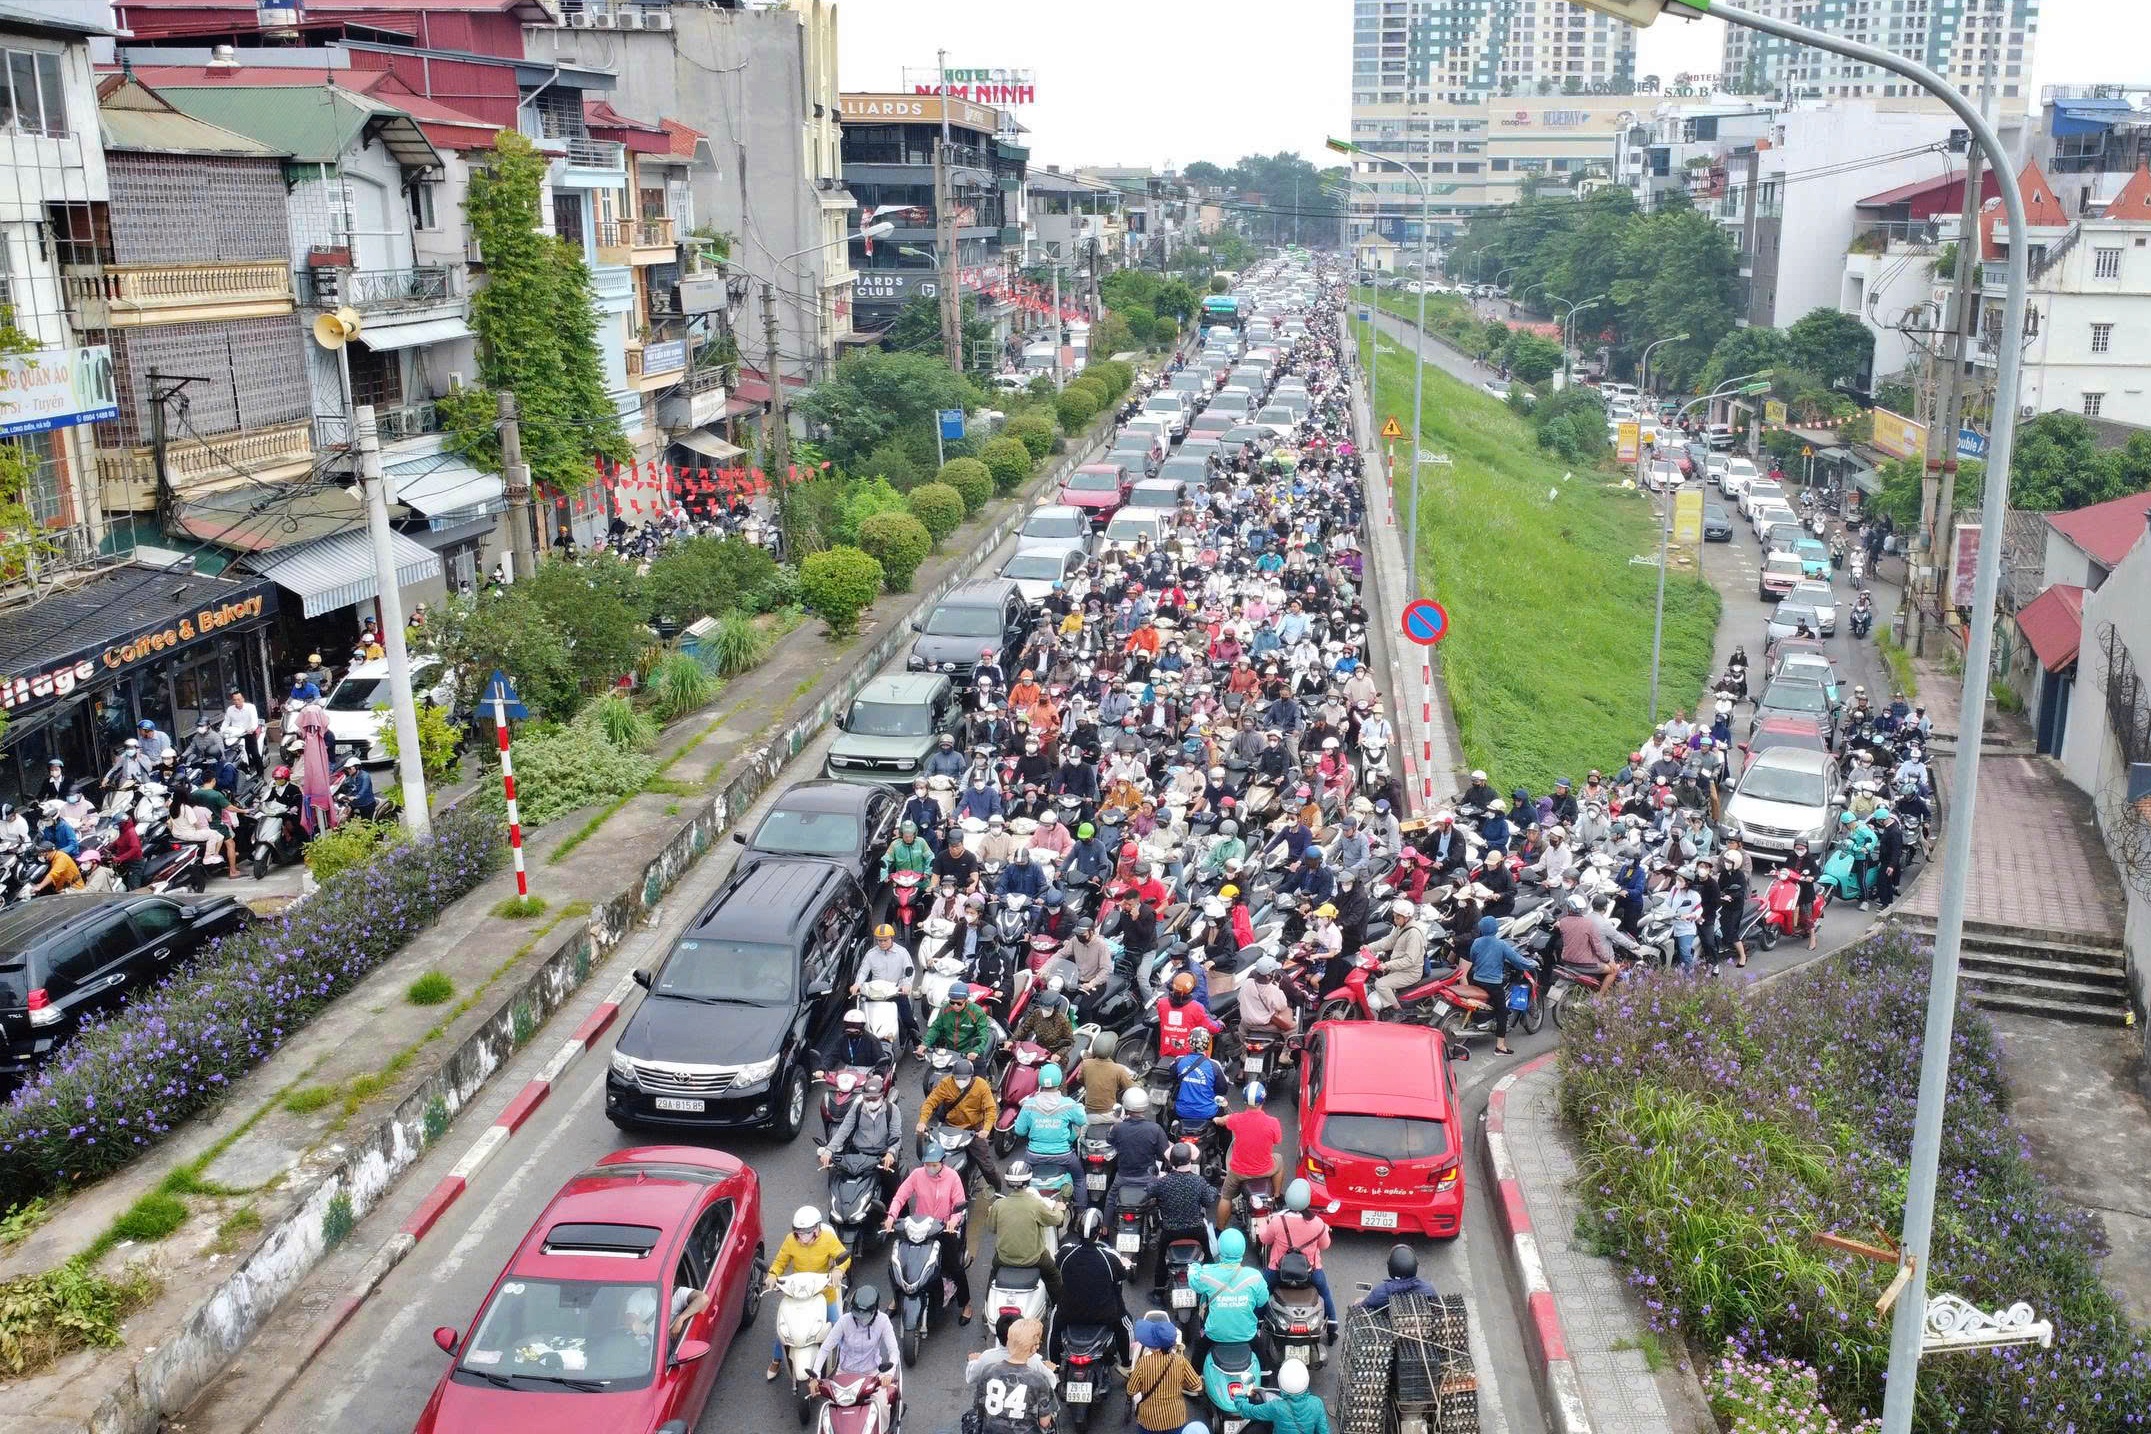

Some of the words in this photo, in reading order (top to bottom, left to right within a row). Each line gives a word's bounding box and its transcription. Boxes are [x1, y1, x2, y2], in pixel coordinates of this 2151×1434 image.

[944, 69, 992, 81] HOTEL
[976, 85, 1034, 103] NINH
[838, 101, 922, 115] LLIARDS
[857, 287, 894, 296] CLUB
[102, 629, 177, 669] Coffee
[179, 618, 196, 641] &
[198, 594, 263, 633] Bakery
[984, 1379, 1028, 1419] 84
